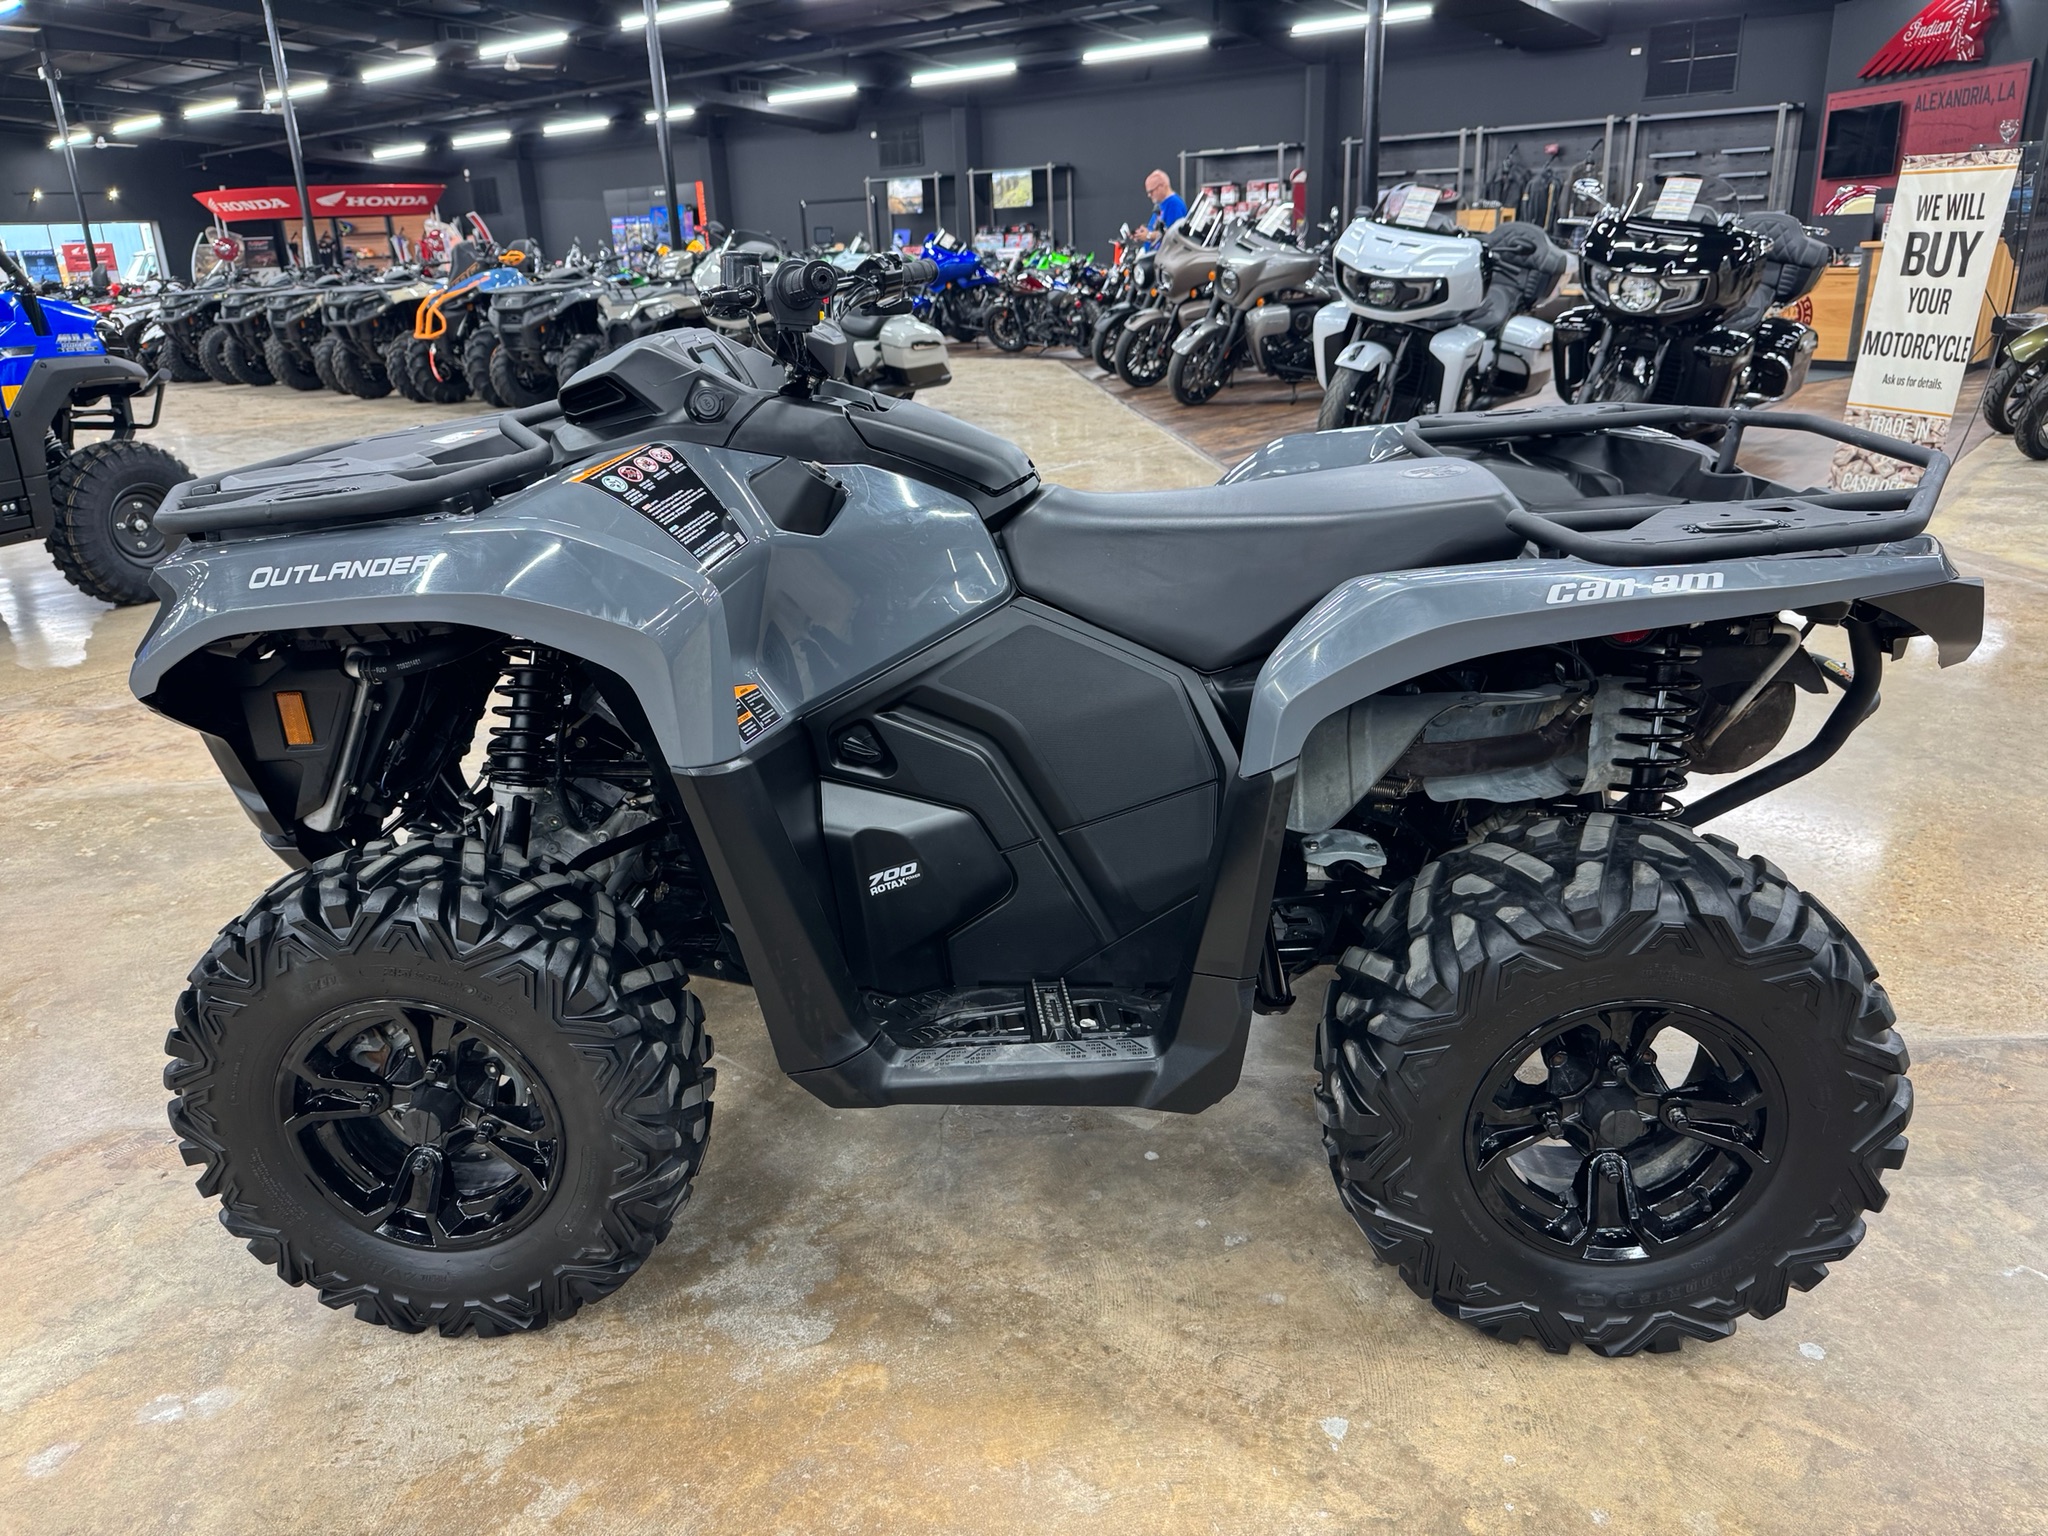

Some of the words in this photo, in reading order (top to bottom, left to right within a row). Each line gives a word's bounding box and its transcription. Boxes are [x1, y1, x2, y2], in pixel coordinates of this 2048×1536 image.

[1903, 16, 1953, 42] Indian
[1914, 84, 1994, 113] ALEXANDRIA,
[1997, 80, 2016, 102] LA
[217, 196, 291, 212] HONDA
[345, 195, 429, 207] HONDA
[1916, 194, 1943, 222] WE
[1946, 192, 1985, 221] WILL
[1900, 230, 1984, 278] BUY
[1908, 287, 1952, 315] YOUR
[1861, 330, 1972, 363] MOTORCYCLE
[1882, 373, 1895, 385] Ask
[1897, 377, 1904, 387] us
[1906, 375, 1916, 387] for
[1917, 376, 1943, 390] details.
[1868, 414, 1931, 440] TRADE-IN
[1841, 472, 1878, 493] CASH
[248, 554, 435, 590] OUTLANDER
[869, 862, 918, 888] 700
[869, 877, 907, 897] ROTAX
